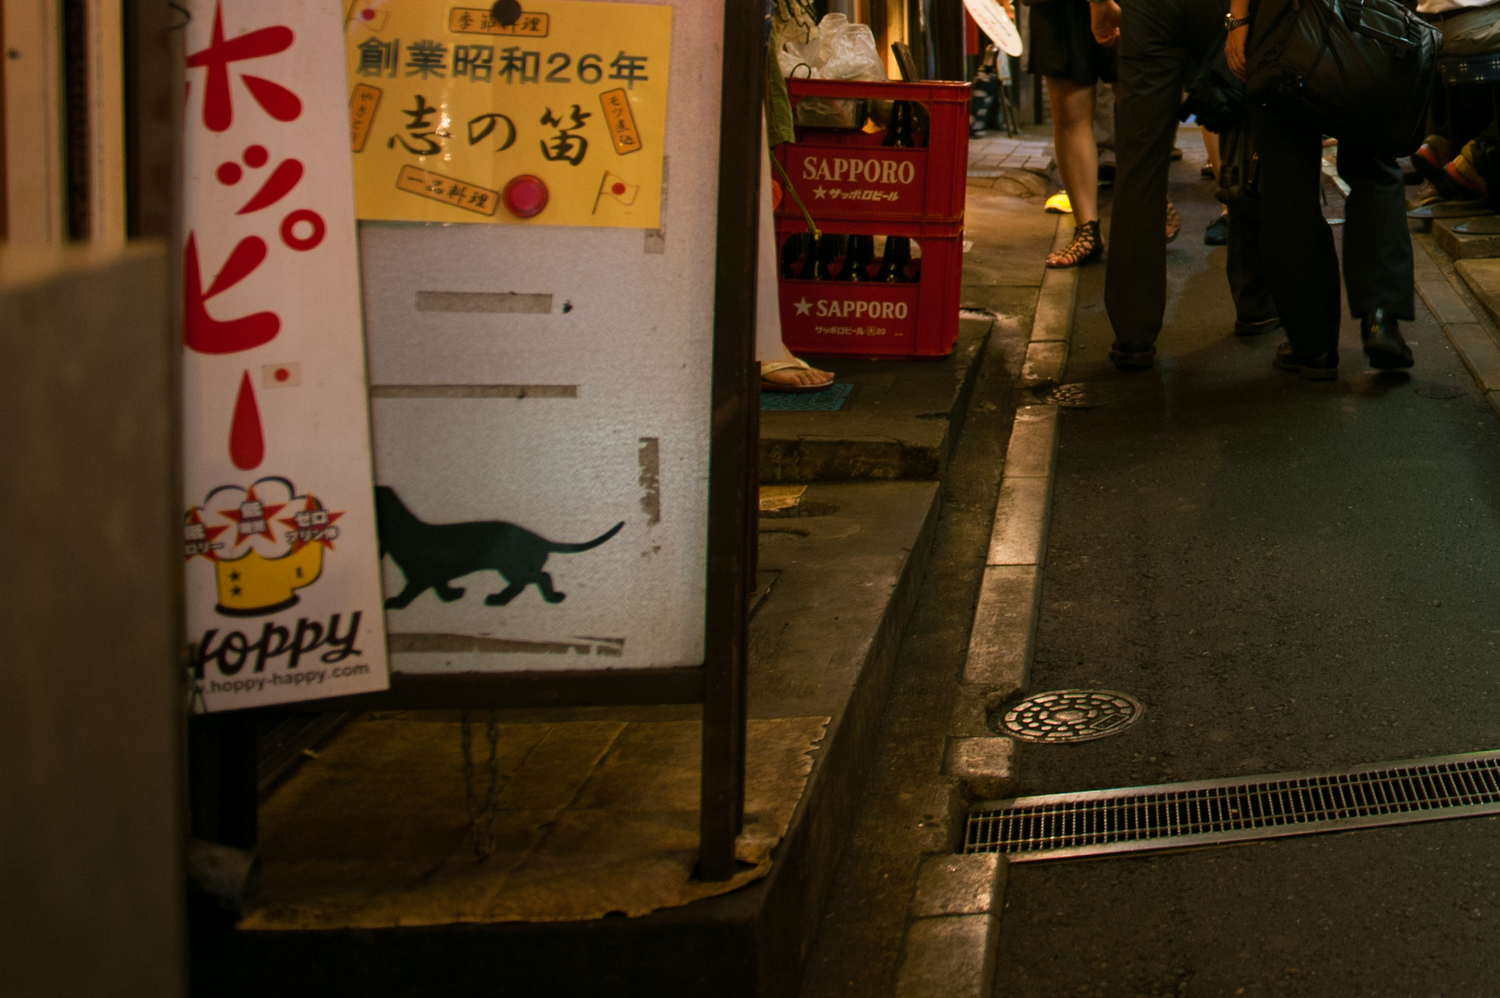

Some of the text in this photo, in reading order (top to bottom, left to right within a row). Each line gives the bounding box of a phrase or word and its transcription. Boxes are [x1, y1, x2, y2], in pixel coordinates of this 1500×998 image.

[355, 36, 649, 90] 創業昭和26年
[387, 94, 592, 167] 志の笛
[802, 156, 916, 185] SAPPORO
[405, 175, 489, 210] 一品料理
[828, 188, 900, 203] サッポロビール
[816, 300, 909, 320] SAPPORO
[814, 325, 865, 336] サッポロビール
[294, 509, 330, 529] ゼロ
[185, 543, 224, 556] ロリー
